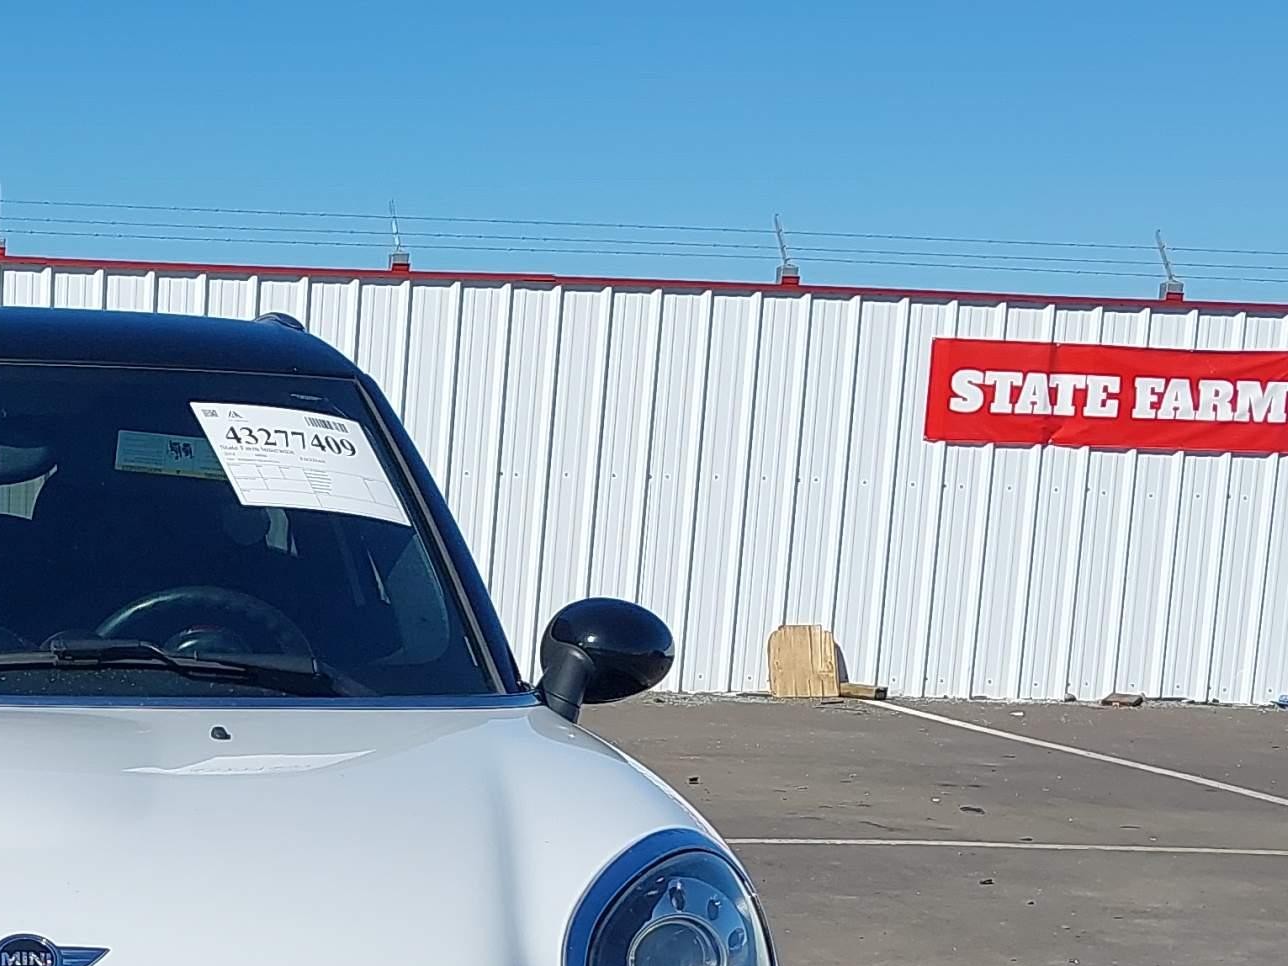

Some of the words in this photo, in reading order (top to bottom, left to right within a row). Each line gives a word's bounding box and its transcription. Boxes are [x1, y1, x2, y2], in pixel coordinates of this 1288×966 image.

[948, 369, 1122, 419] STATE
[1131, 377, 1288, 424] FARM
[225, 425, 357, 457] 43277409
[1, 951, 52, 966] MINI
